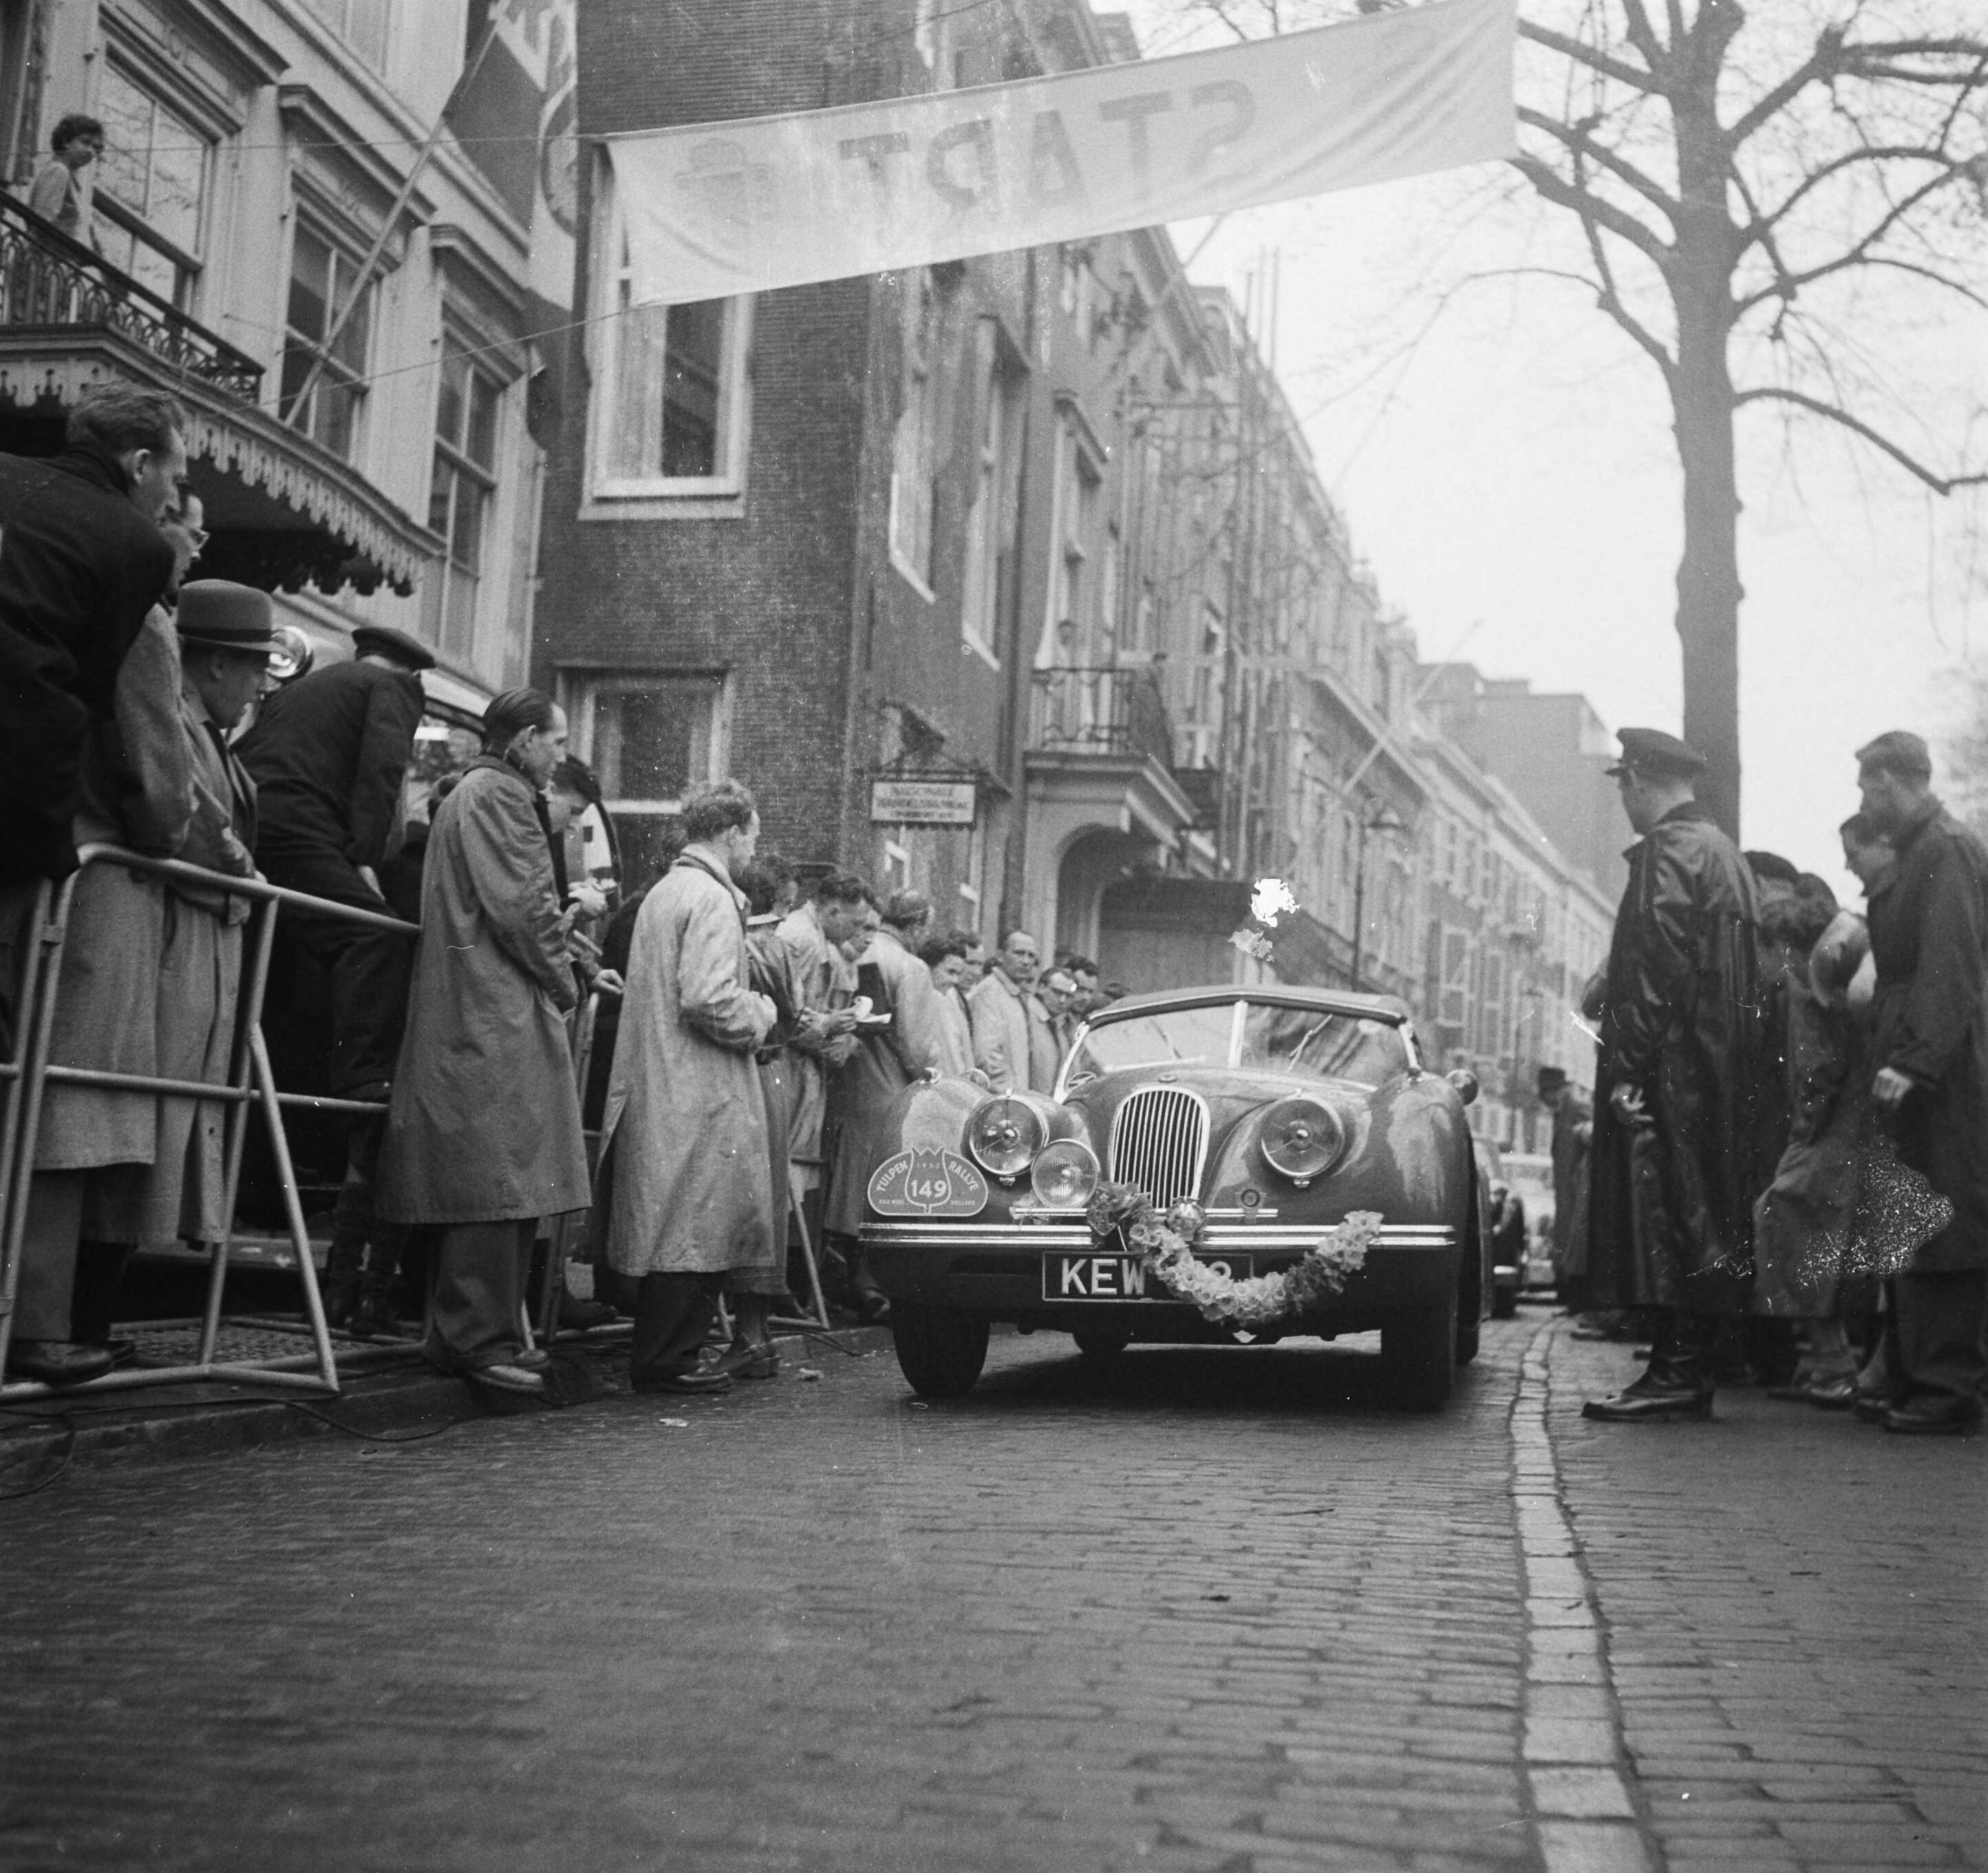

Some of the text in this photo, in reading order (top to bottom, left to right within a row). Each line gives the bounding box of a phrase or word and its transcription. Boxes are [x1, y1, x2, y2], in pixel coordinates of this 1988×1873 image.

[876, 1160, 979, 1192] TULPEN RALLYE
[910, 1179, 947, 1197] 149
[1061, 1258, 1145, 1294] KEW
